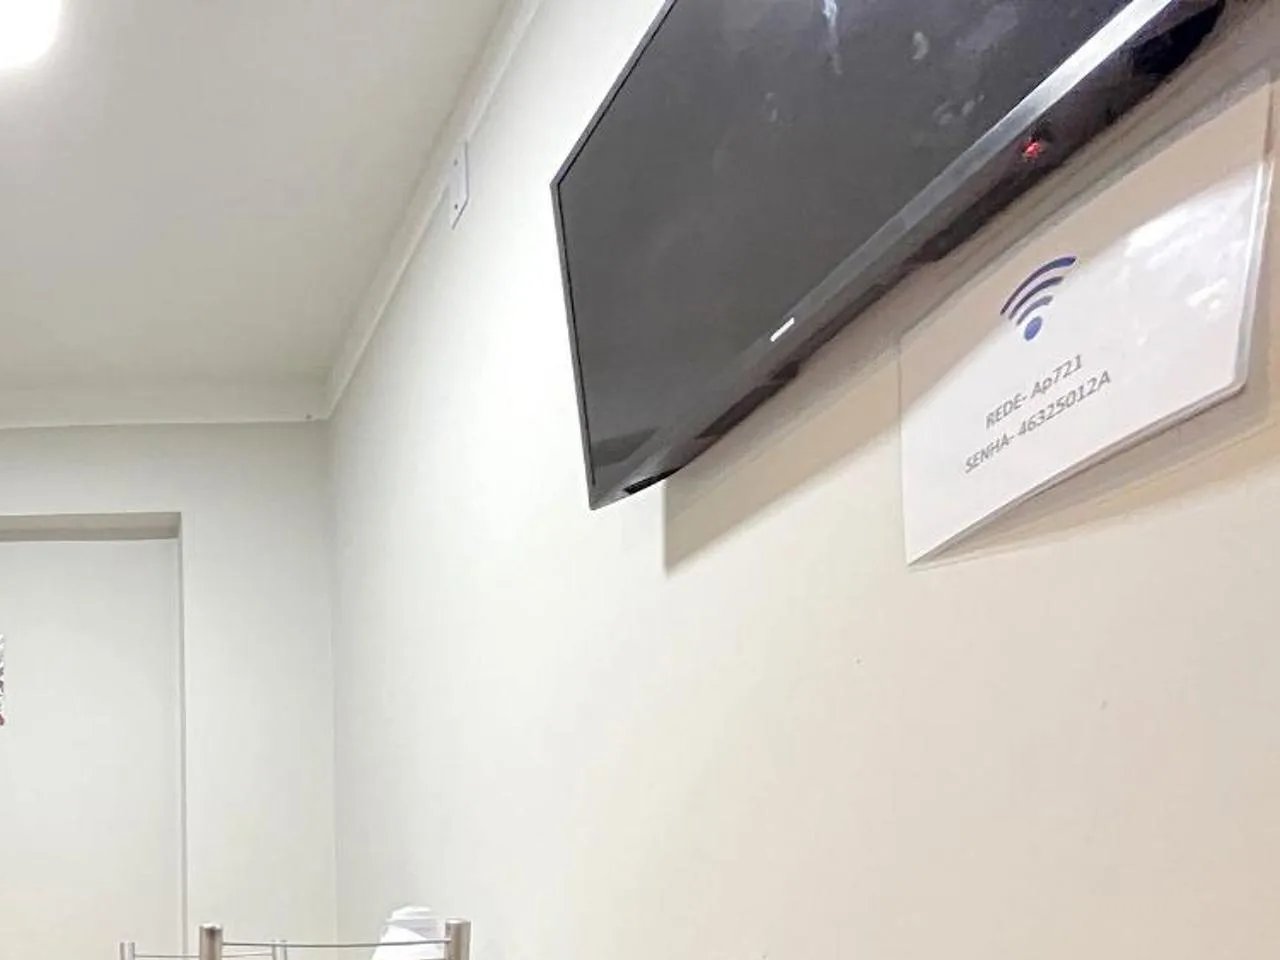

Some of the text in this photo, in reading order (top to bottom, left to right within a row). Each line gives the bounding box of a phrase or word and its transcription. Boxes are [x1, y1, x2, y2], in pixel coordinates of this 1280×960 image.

[964, 369, 1112, 474] SENHA- 46325012A
[985, 354, 1083, 429] REDE- Ap721
